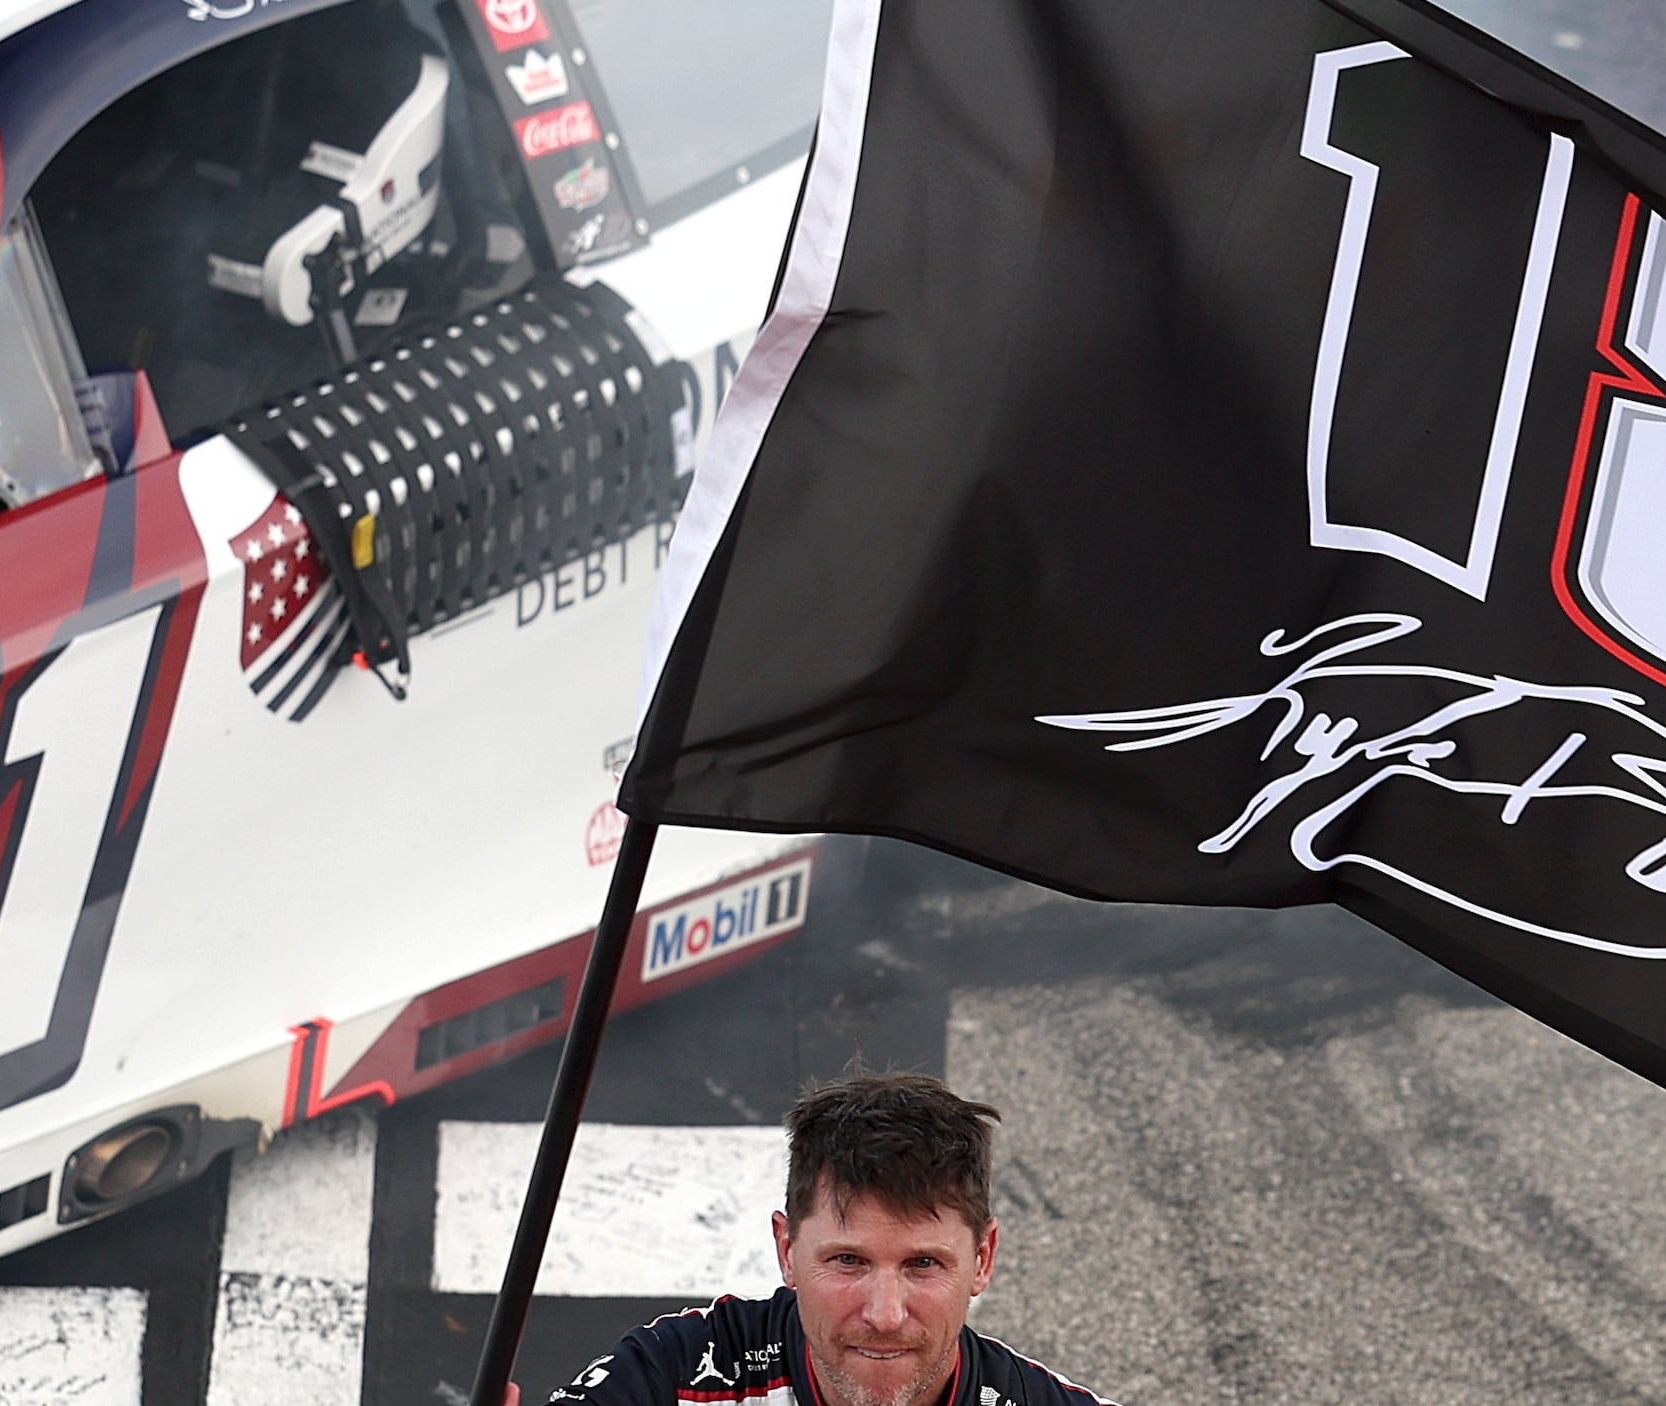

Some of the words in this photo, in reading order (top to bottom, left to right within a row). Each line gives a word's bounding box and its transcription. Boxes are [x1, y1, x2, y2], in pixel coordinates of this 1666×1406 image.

[516, 544, 629, 628] DEBT
[649, 885, 761, 971] Mobil
[767, 874, 802, 926] 1
